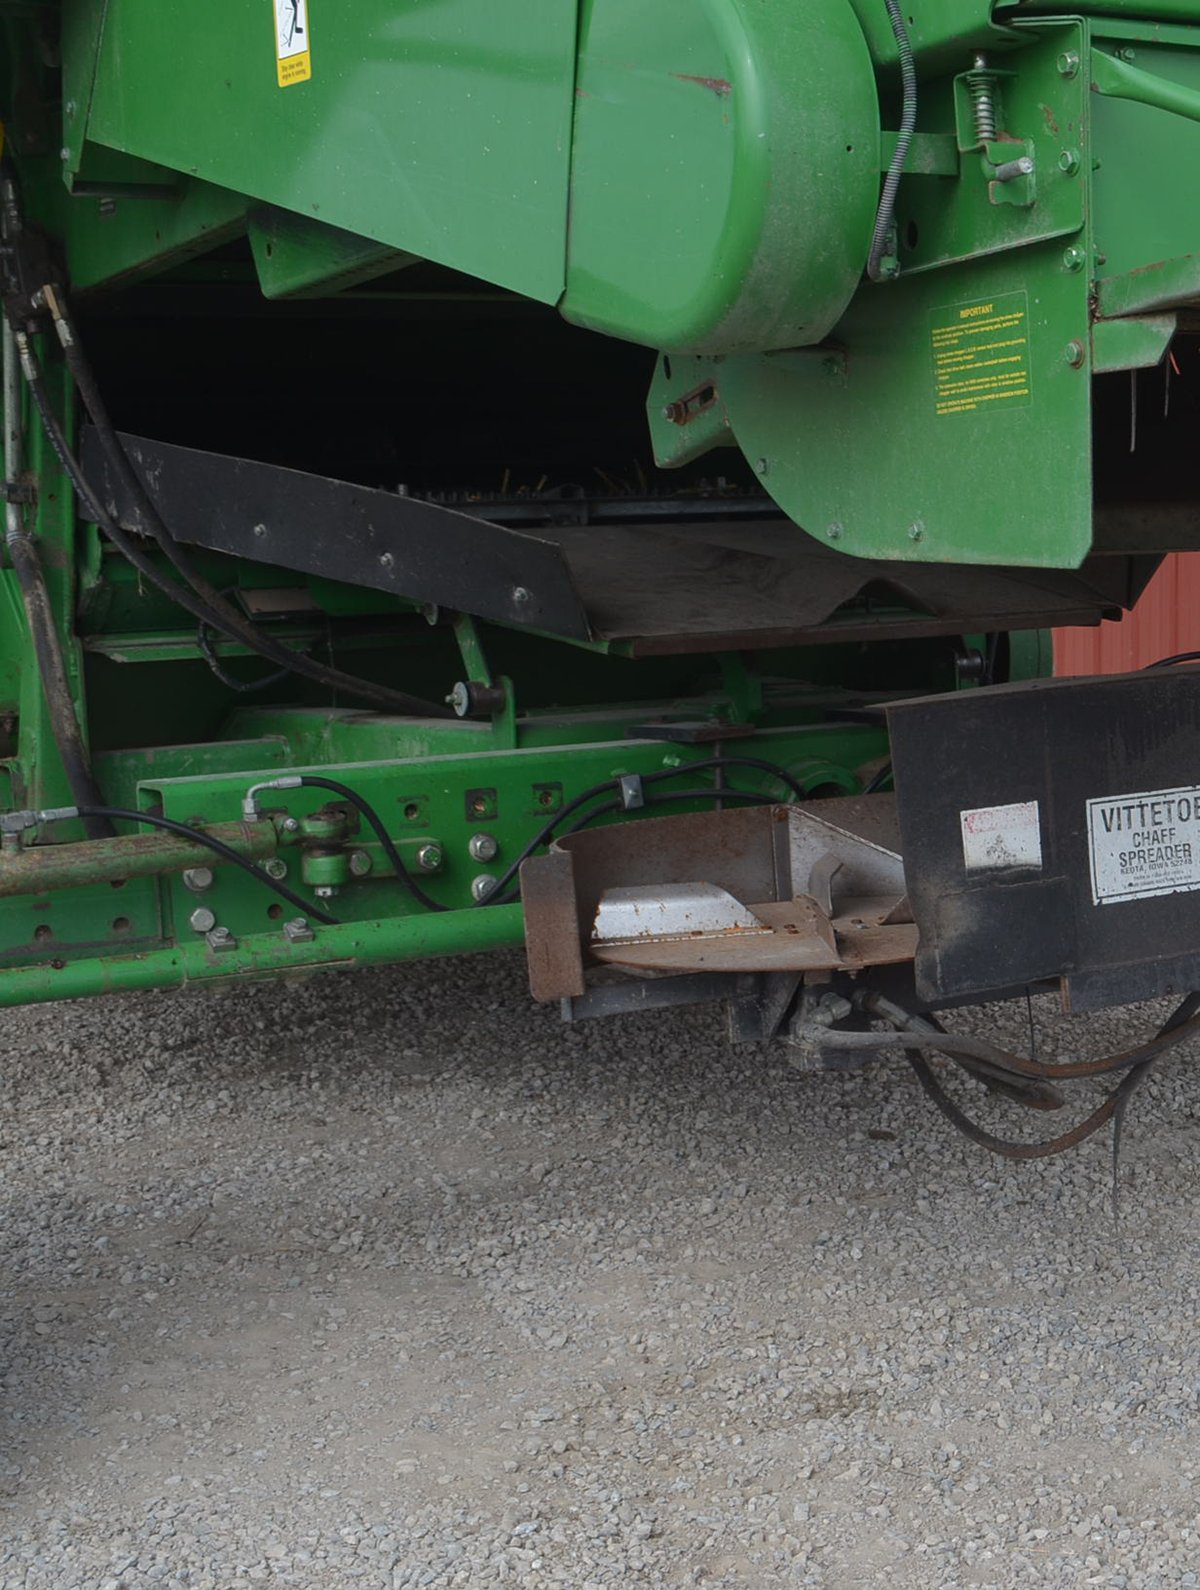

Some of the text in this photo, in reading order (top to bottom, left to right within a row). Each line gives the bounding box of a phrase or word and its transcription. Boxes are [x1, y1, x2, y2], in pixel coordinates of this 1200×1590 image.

[959, 304, 993, 319] IMPORTANT
[1132, 827, 1176, 848] CHAFF
[1118, 843, 1192, 868] SPREADER
